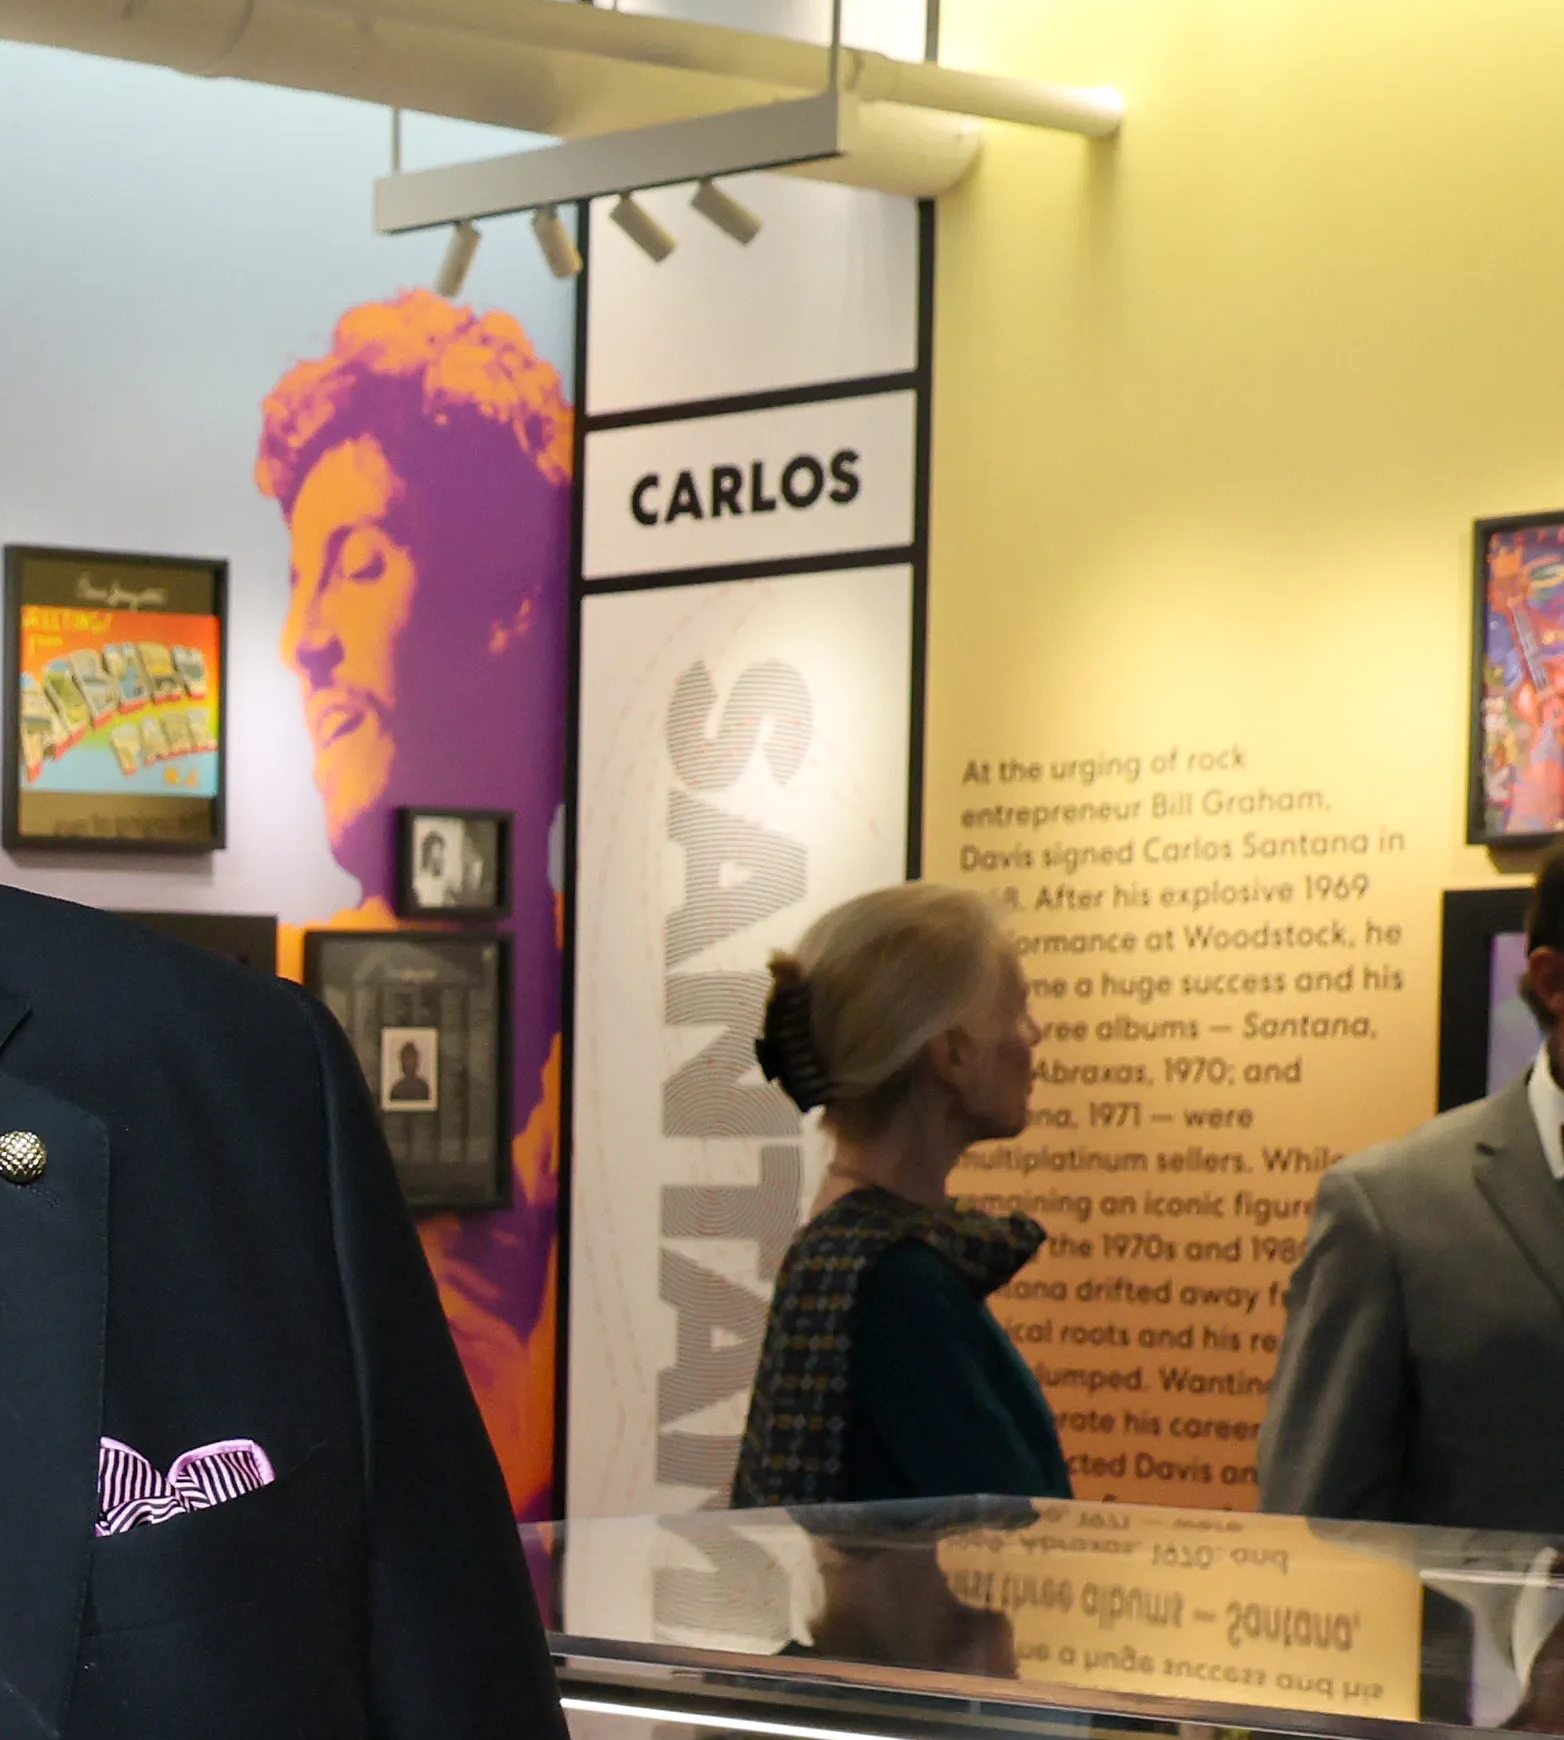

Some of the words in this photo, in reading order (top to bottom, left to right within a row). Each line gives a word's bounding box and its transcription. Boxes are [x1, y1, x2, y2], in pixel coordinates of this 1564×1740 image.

[631, 449, 860, 526] CARLOS
[962, 759, 990, 785] At
[999, 757, 1043, 783] the
[1050, 753, 1141, 787] urging
[1150, 746, 1179, 774] of
[1186, 744, 1246, 772] rock
[961, 803, 1141, 831] entrepreneur
[1151, 792, 1193, 819] Bill
[960, 844, 1034, 873] Davis
[1044, 839, 1135, 875] signed
[1143, 836, 1233, 864] Carlos
[1242, 831, 1369, 859] Santana
[1379, 827, 1406, 852] in
[1034, 885, 1104, 912] After
[1113, 882, 1151, 908] his
[1159, 876, 1295, 912] explosive
[1305, 873, 1369, 902] 1969
[1015, 930, 1137, 956] ormance
[1146, 930, 1175, 954] at
[1366, 919, 1403, 946] he
[1075, 977, 1094, 999] a
[1101, 971, 1172, 1004] huge
[1180, 971, 1286, 998] success
[1295, 965, 1354, 992] and
[1362, 964, 1405, 992] his
[1040, 1020, 1087, 1042] ree
[1095, 1012, 1200, 1042] albums
[1243, 1011, 1378, 1040] Santana,
[1165, 1057, 1236, 1087] 1970;
[1244, 1057, 1302, 1084] and
[1089, 1101, 1142, 1128] 1971
[1184, 1108, 1254, 1128] were
[1157, 1146, 1254, 1174] sellers.
[972, 1192, 1092, 1222] maining
[1100, 1197, 1137, 1217] an
[1145, 1192, 1224, 1218] iconic
[1049, 1234, 1092, 1258] the
[1103, 1234, 1177, 1261] 1970s
[1186, 1236, 1241, 1262] and
[1251, 1237, 1308, 1264] 198
[1077, 1278, 1171, 1303] drifted
[1180, 1284, 1259, 1313] away
[1060, 1324, 1129, 1348] roots
[1138, 1324, 1194, 1351] and
[1203, 1325, 1242, 1353] his
[1036, 1365, 1148, 1394] lumped.
[1123, 1414, 1162, 1438] his
[1134, 1455, 1213, 1485] Davis
